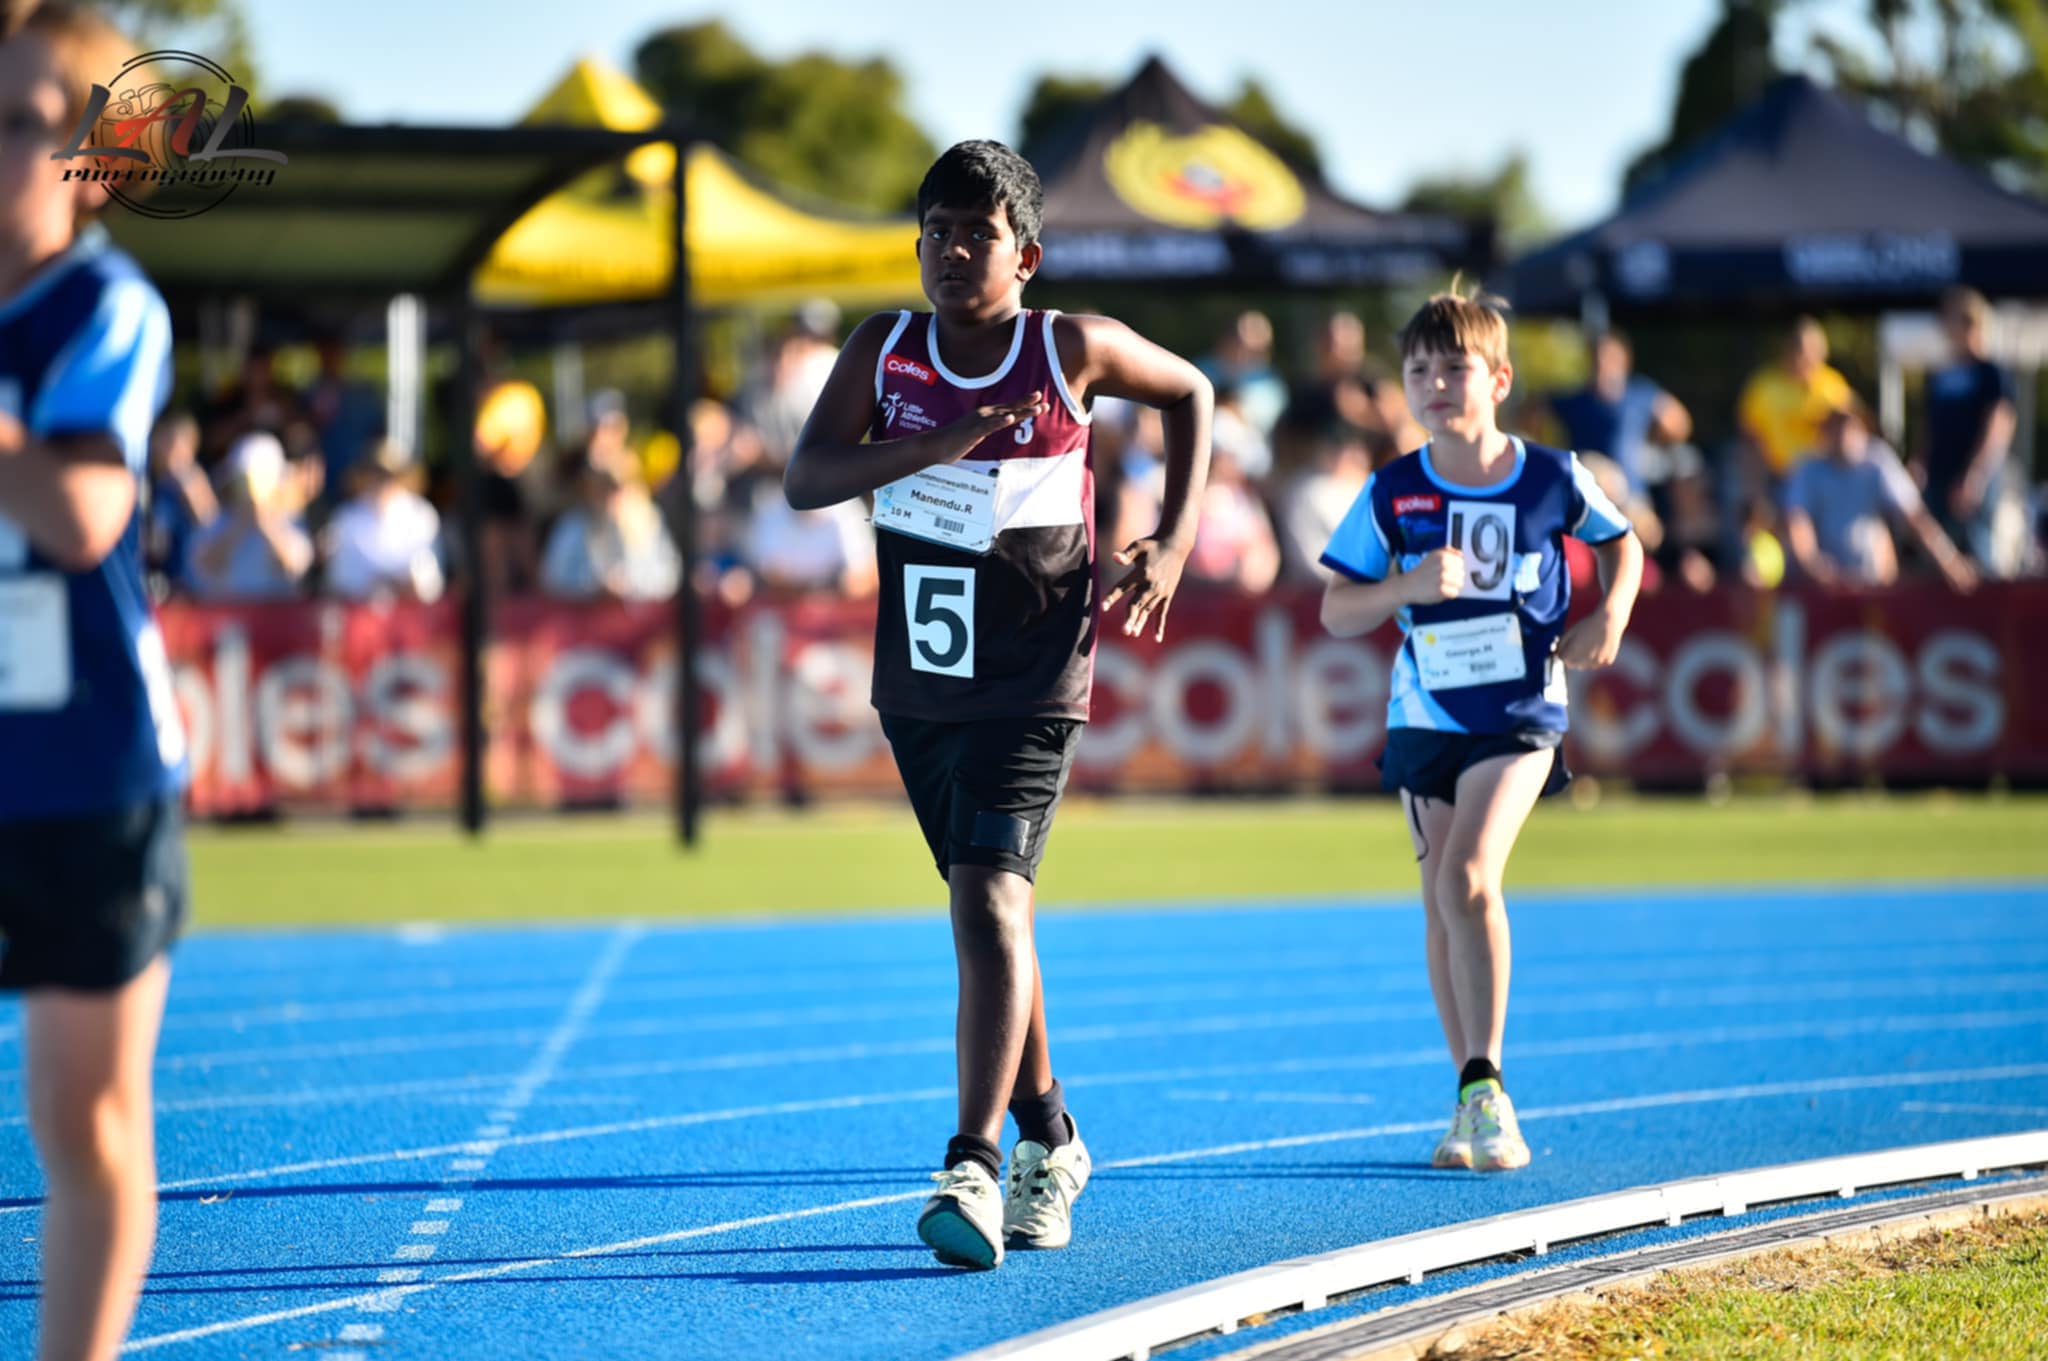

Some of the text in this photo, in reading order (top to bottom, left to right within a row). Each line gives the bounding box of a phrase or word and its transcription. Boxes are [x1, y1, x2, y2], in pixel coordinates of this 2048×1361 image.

[887, 359, 929, 381] coles
[890, 506, 912, 519] 10 M
[910, 489, 973, 515] Manendu.R
[914, 577, 968, 668] 5
[173, 602, 2004, 788] les cole cole coles
